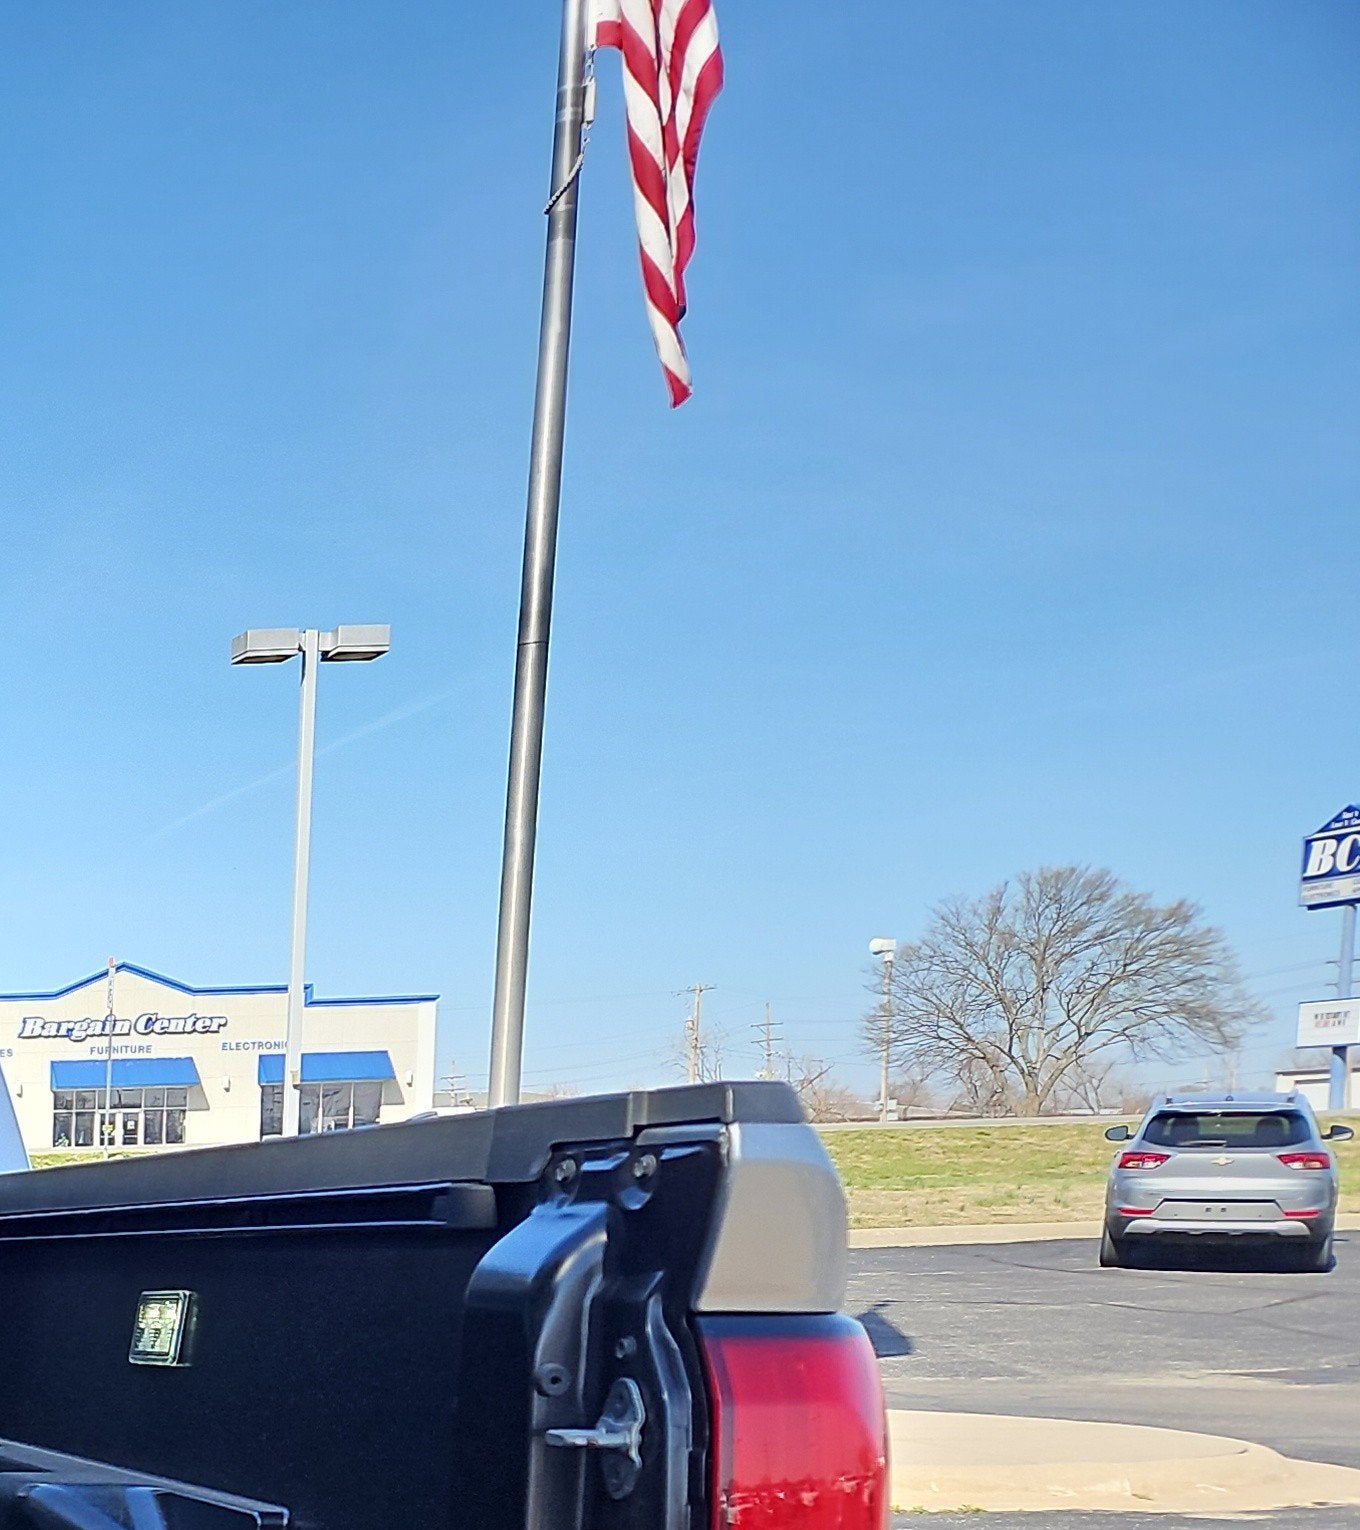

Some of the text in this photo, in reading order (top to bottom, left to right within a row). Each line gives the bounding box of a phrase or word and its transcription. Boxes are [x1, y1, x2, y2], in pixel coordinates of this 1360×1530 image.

[18, 1012, 227, 1042] Bargain Center
[90, 1044, 153, 1056] FURNITURE
